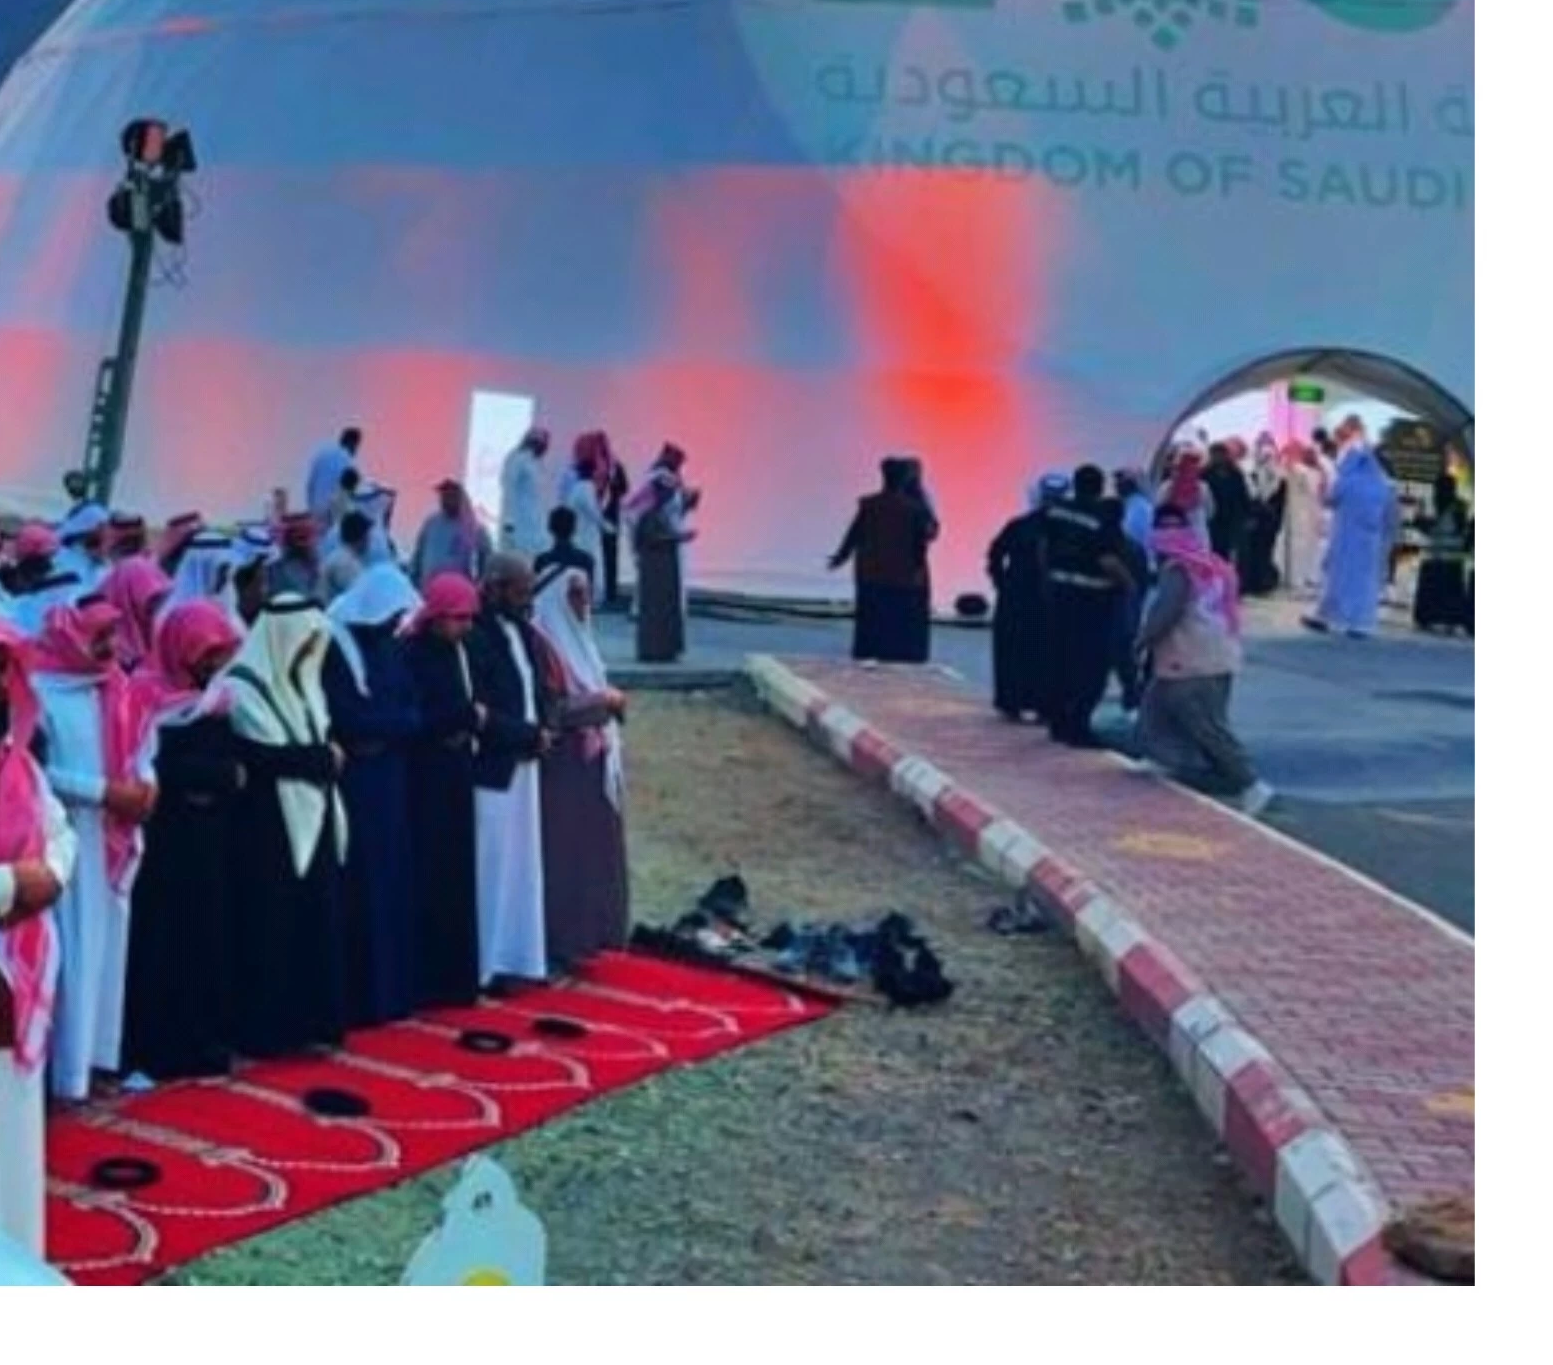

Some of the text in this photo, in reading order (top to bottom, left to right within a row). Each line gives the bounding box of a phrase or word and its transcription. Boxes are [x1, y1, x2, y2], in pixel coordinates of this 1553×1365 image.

[813, 54, 1168, 123] السعودية
[1194, 69, 1409, 141] العربية
[1165, 151, 1252, 199] OF
[1278, 158, 1467, 209] SAUDI
